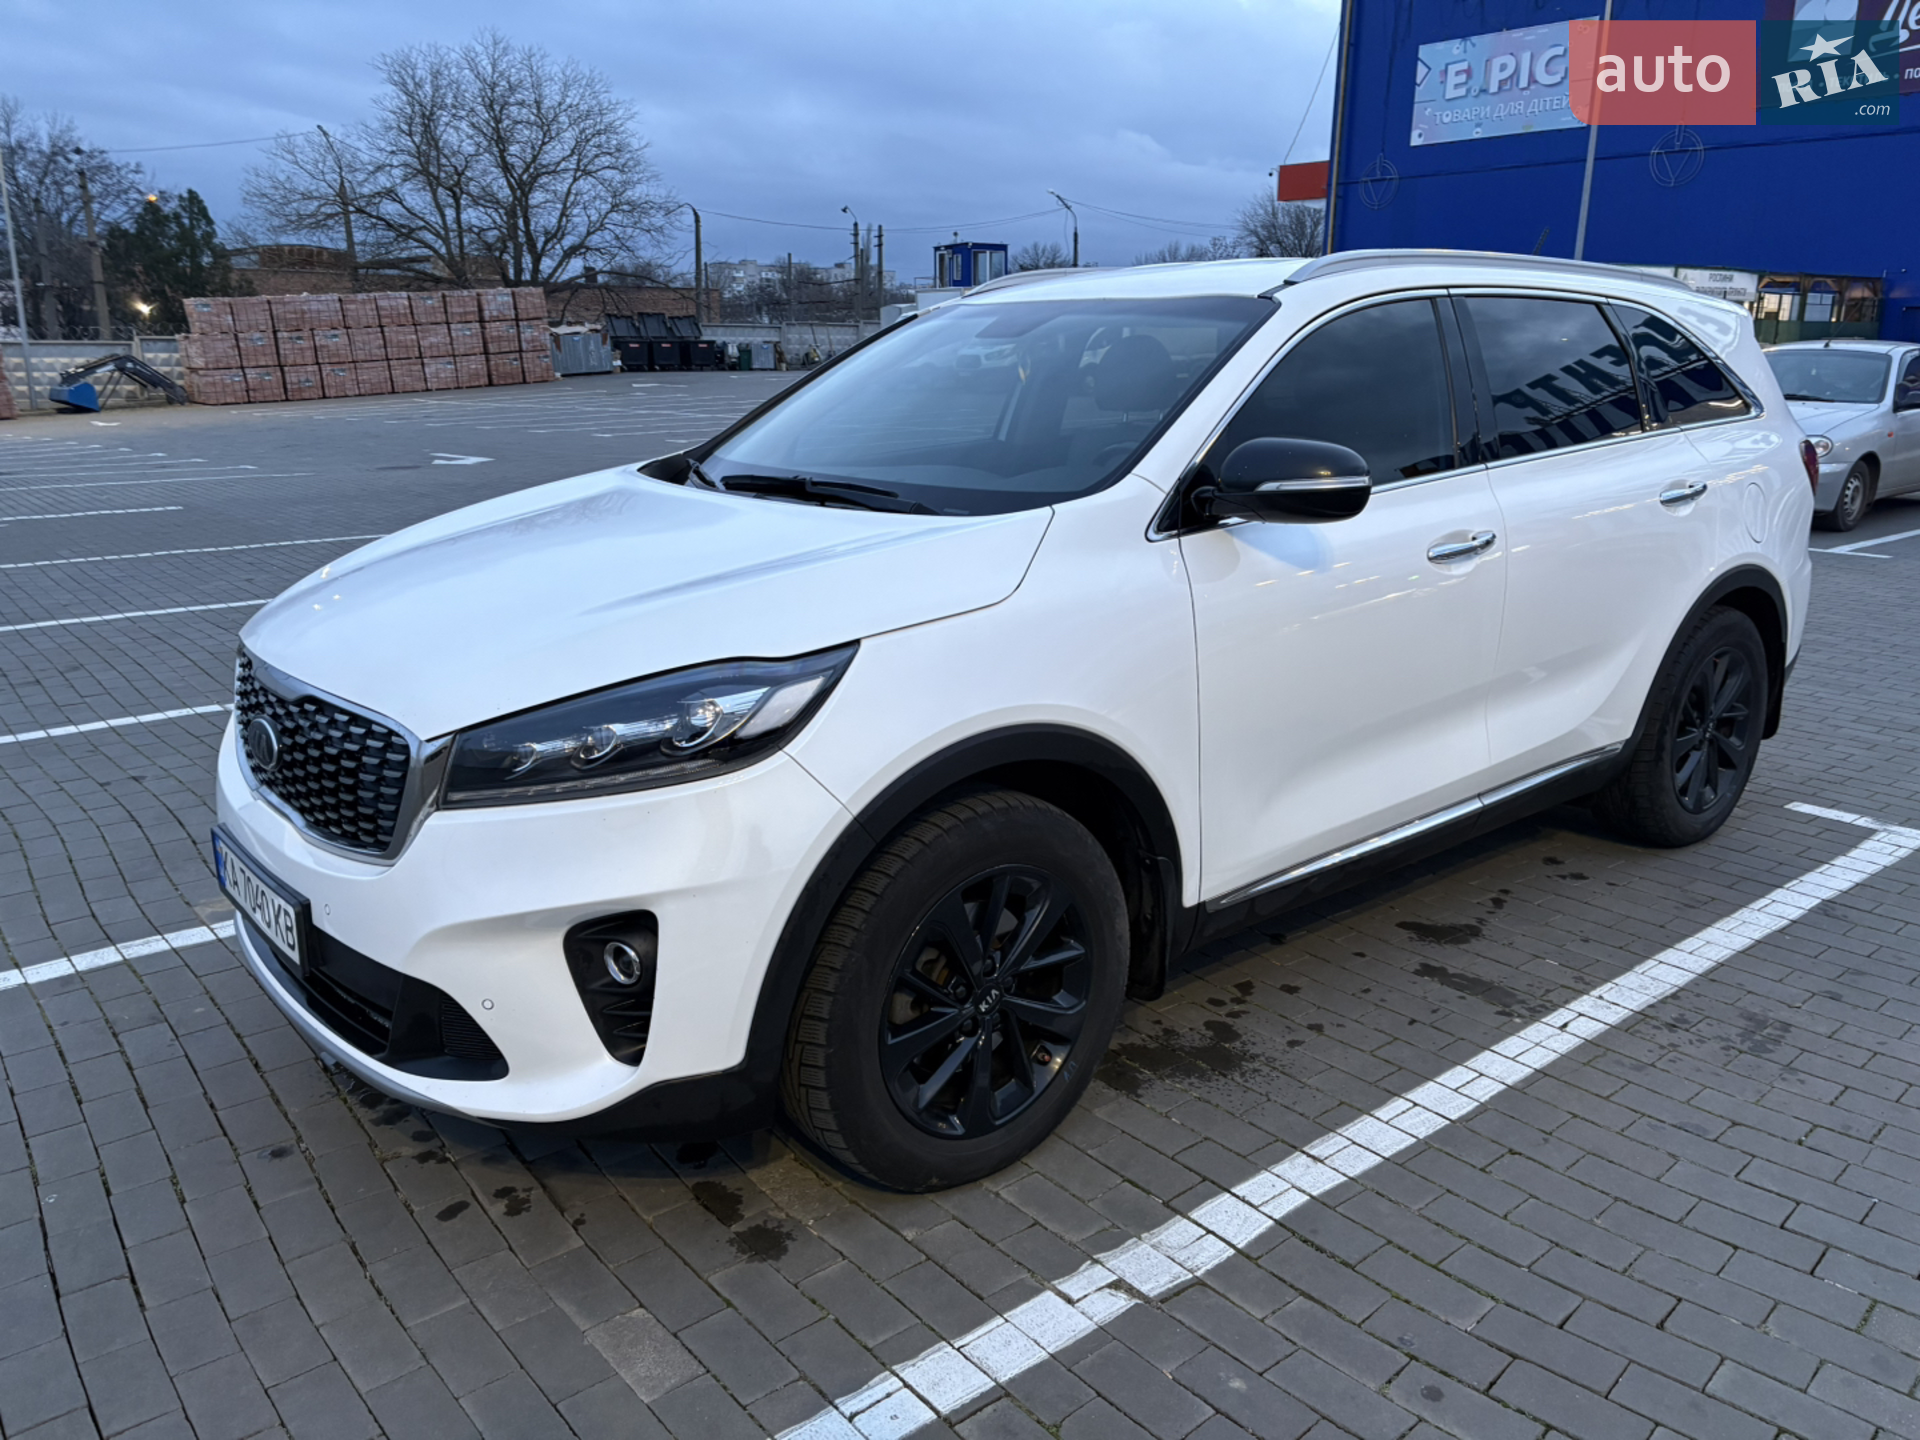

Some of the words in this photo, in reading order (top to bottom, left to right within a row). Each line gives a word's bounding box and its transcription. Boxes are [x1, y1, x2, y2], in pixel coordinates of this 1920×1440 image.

[1433, 106, 1490, 125] ТОВАРИ
[1493, 100, 1524, 121] ДЛЯ
[1527, 92, 1571, 117] ДІТЕЙ
[979, 989, 1000, 1012] KIA
